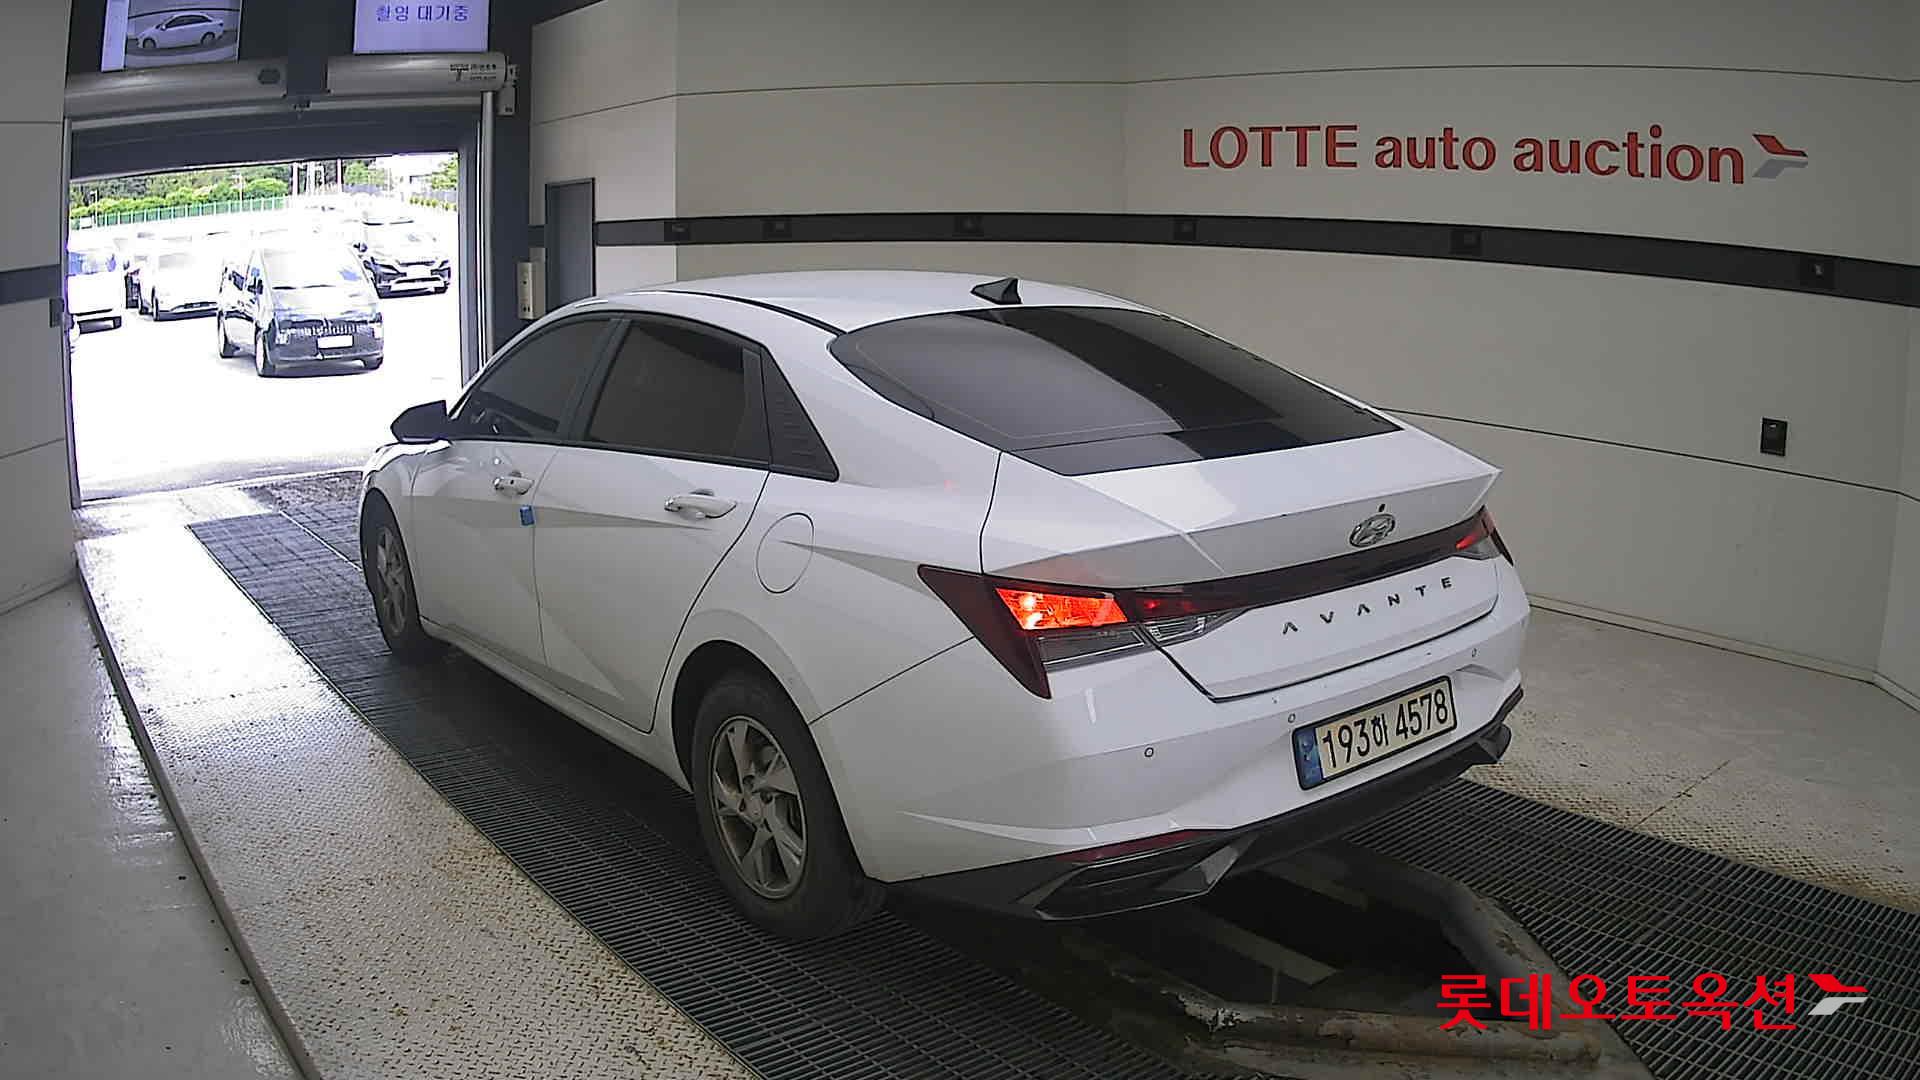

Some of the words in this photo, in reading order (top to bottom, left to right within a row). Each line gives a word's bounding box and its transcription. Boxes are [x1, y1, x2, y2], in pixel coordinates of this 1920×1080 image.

[417, 5, 469, 22] 대기중
[1183, 124, 1358, 169] LOTTE
[1374, 127, 1497, 171] auto
[1513, 124, 1745, 184] auction
[1282, 576, 1452, 635] AVANTE
[1321, 712, 1389, 769] 193하
[1395, 689, 1448, 740] 4578
